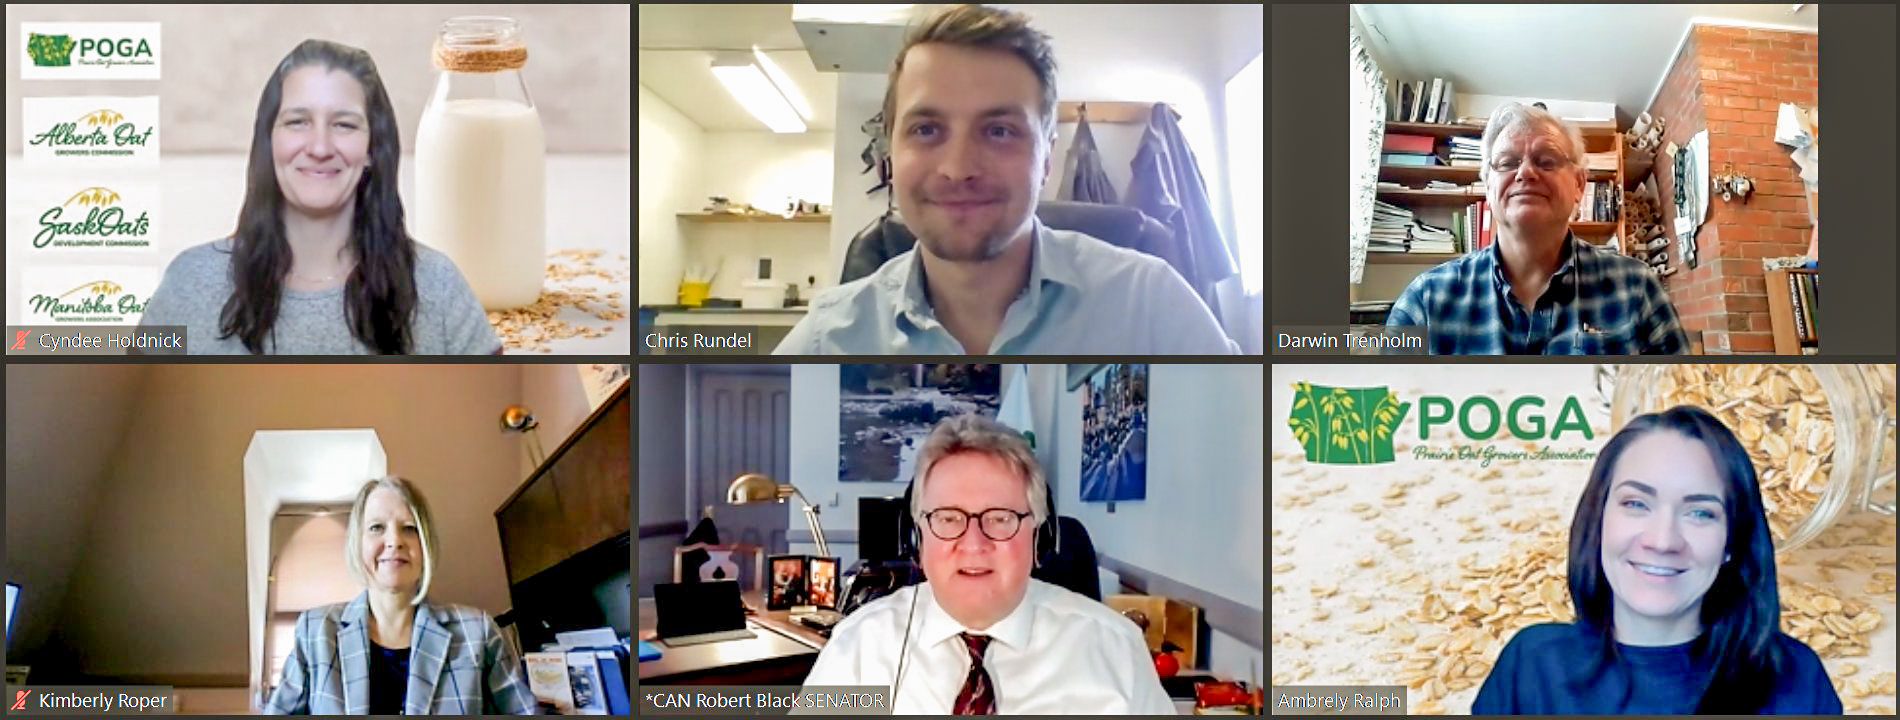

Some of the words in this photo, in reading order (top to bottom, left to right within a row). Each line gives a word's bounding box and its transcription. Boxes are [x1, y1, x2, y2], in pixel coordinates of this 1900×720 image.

[80, 38, 152, 57] POGA
[29, 122, 109, 147] Alberta
[113, 122, 153, 147] Oat
[33, 206, 149, 248] SaskOats
[29, 294, 113, 317] Manitoba
[1419, 395, 1595, 441] POGA
